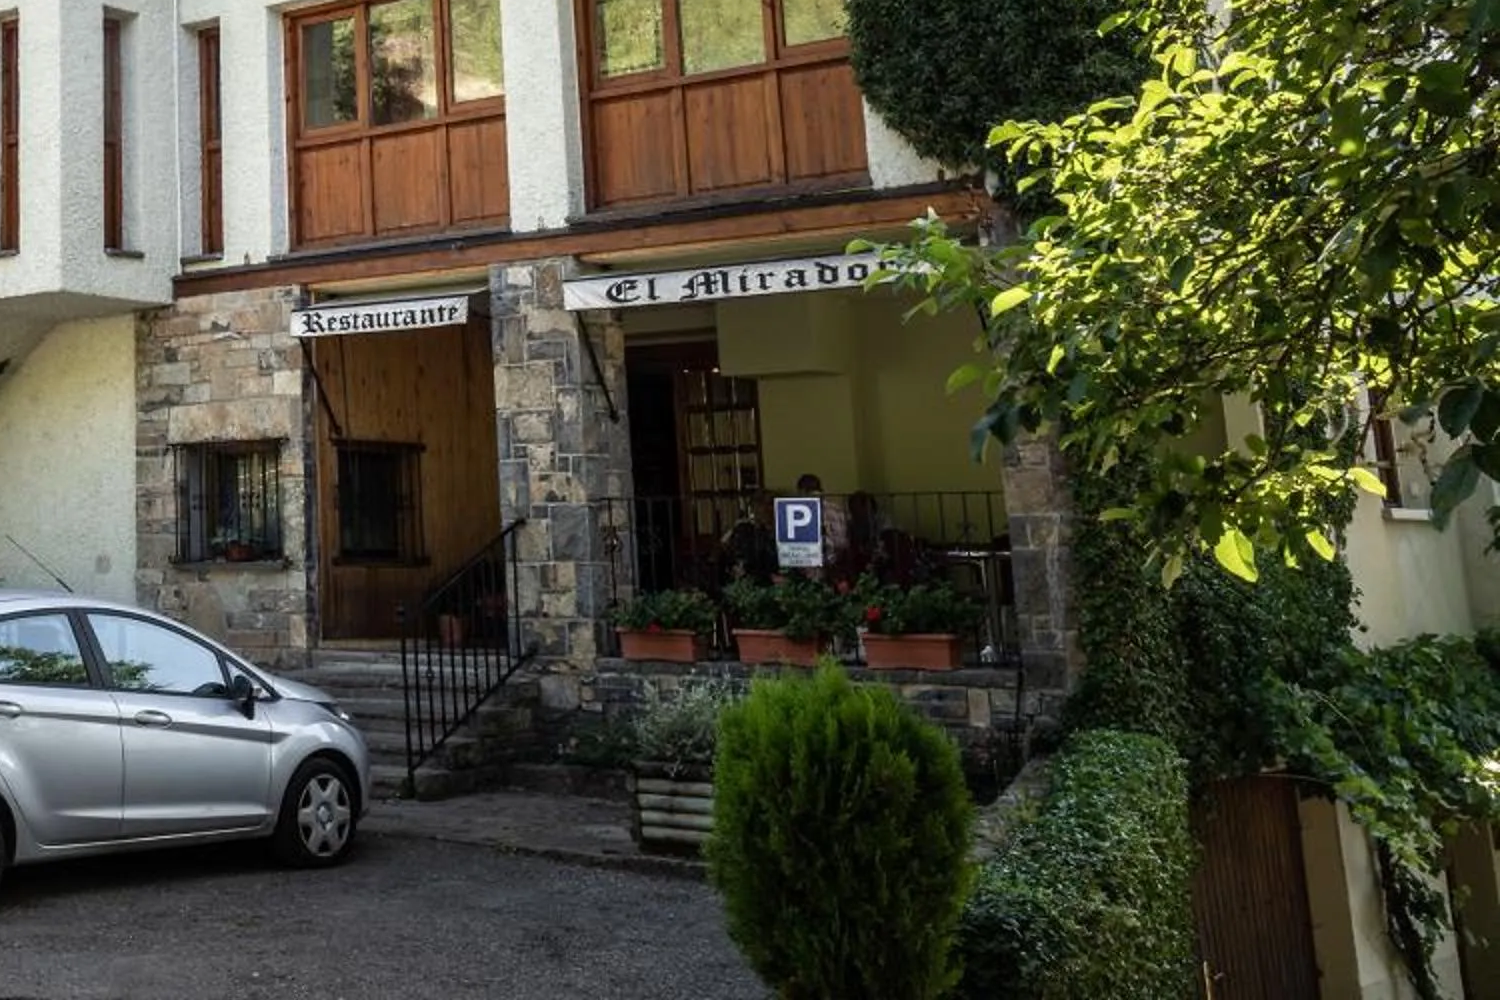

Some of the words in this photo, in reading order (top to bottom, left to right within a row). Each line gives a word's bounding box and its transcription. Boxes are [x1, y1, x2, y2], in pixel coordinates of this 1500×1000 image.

[605, 278, 658, 304] El
[302, 304, 459, 334] Restaurante
[785, 504, 812, 539] P
